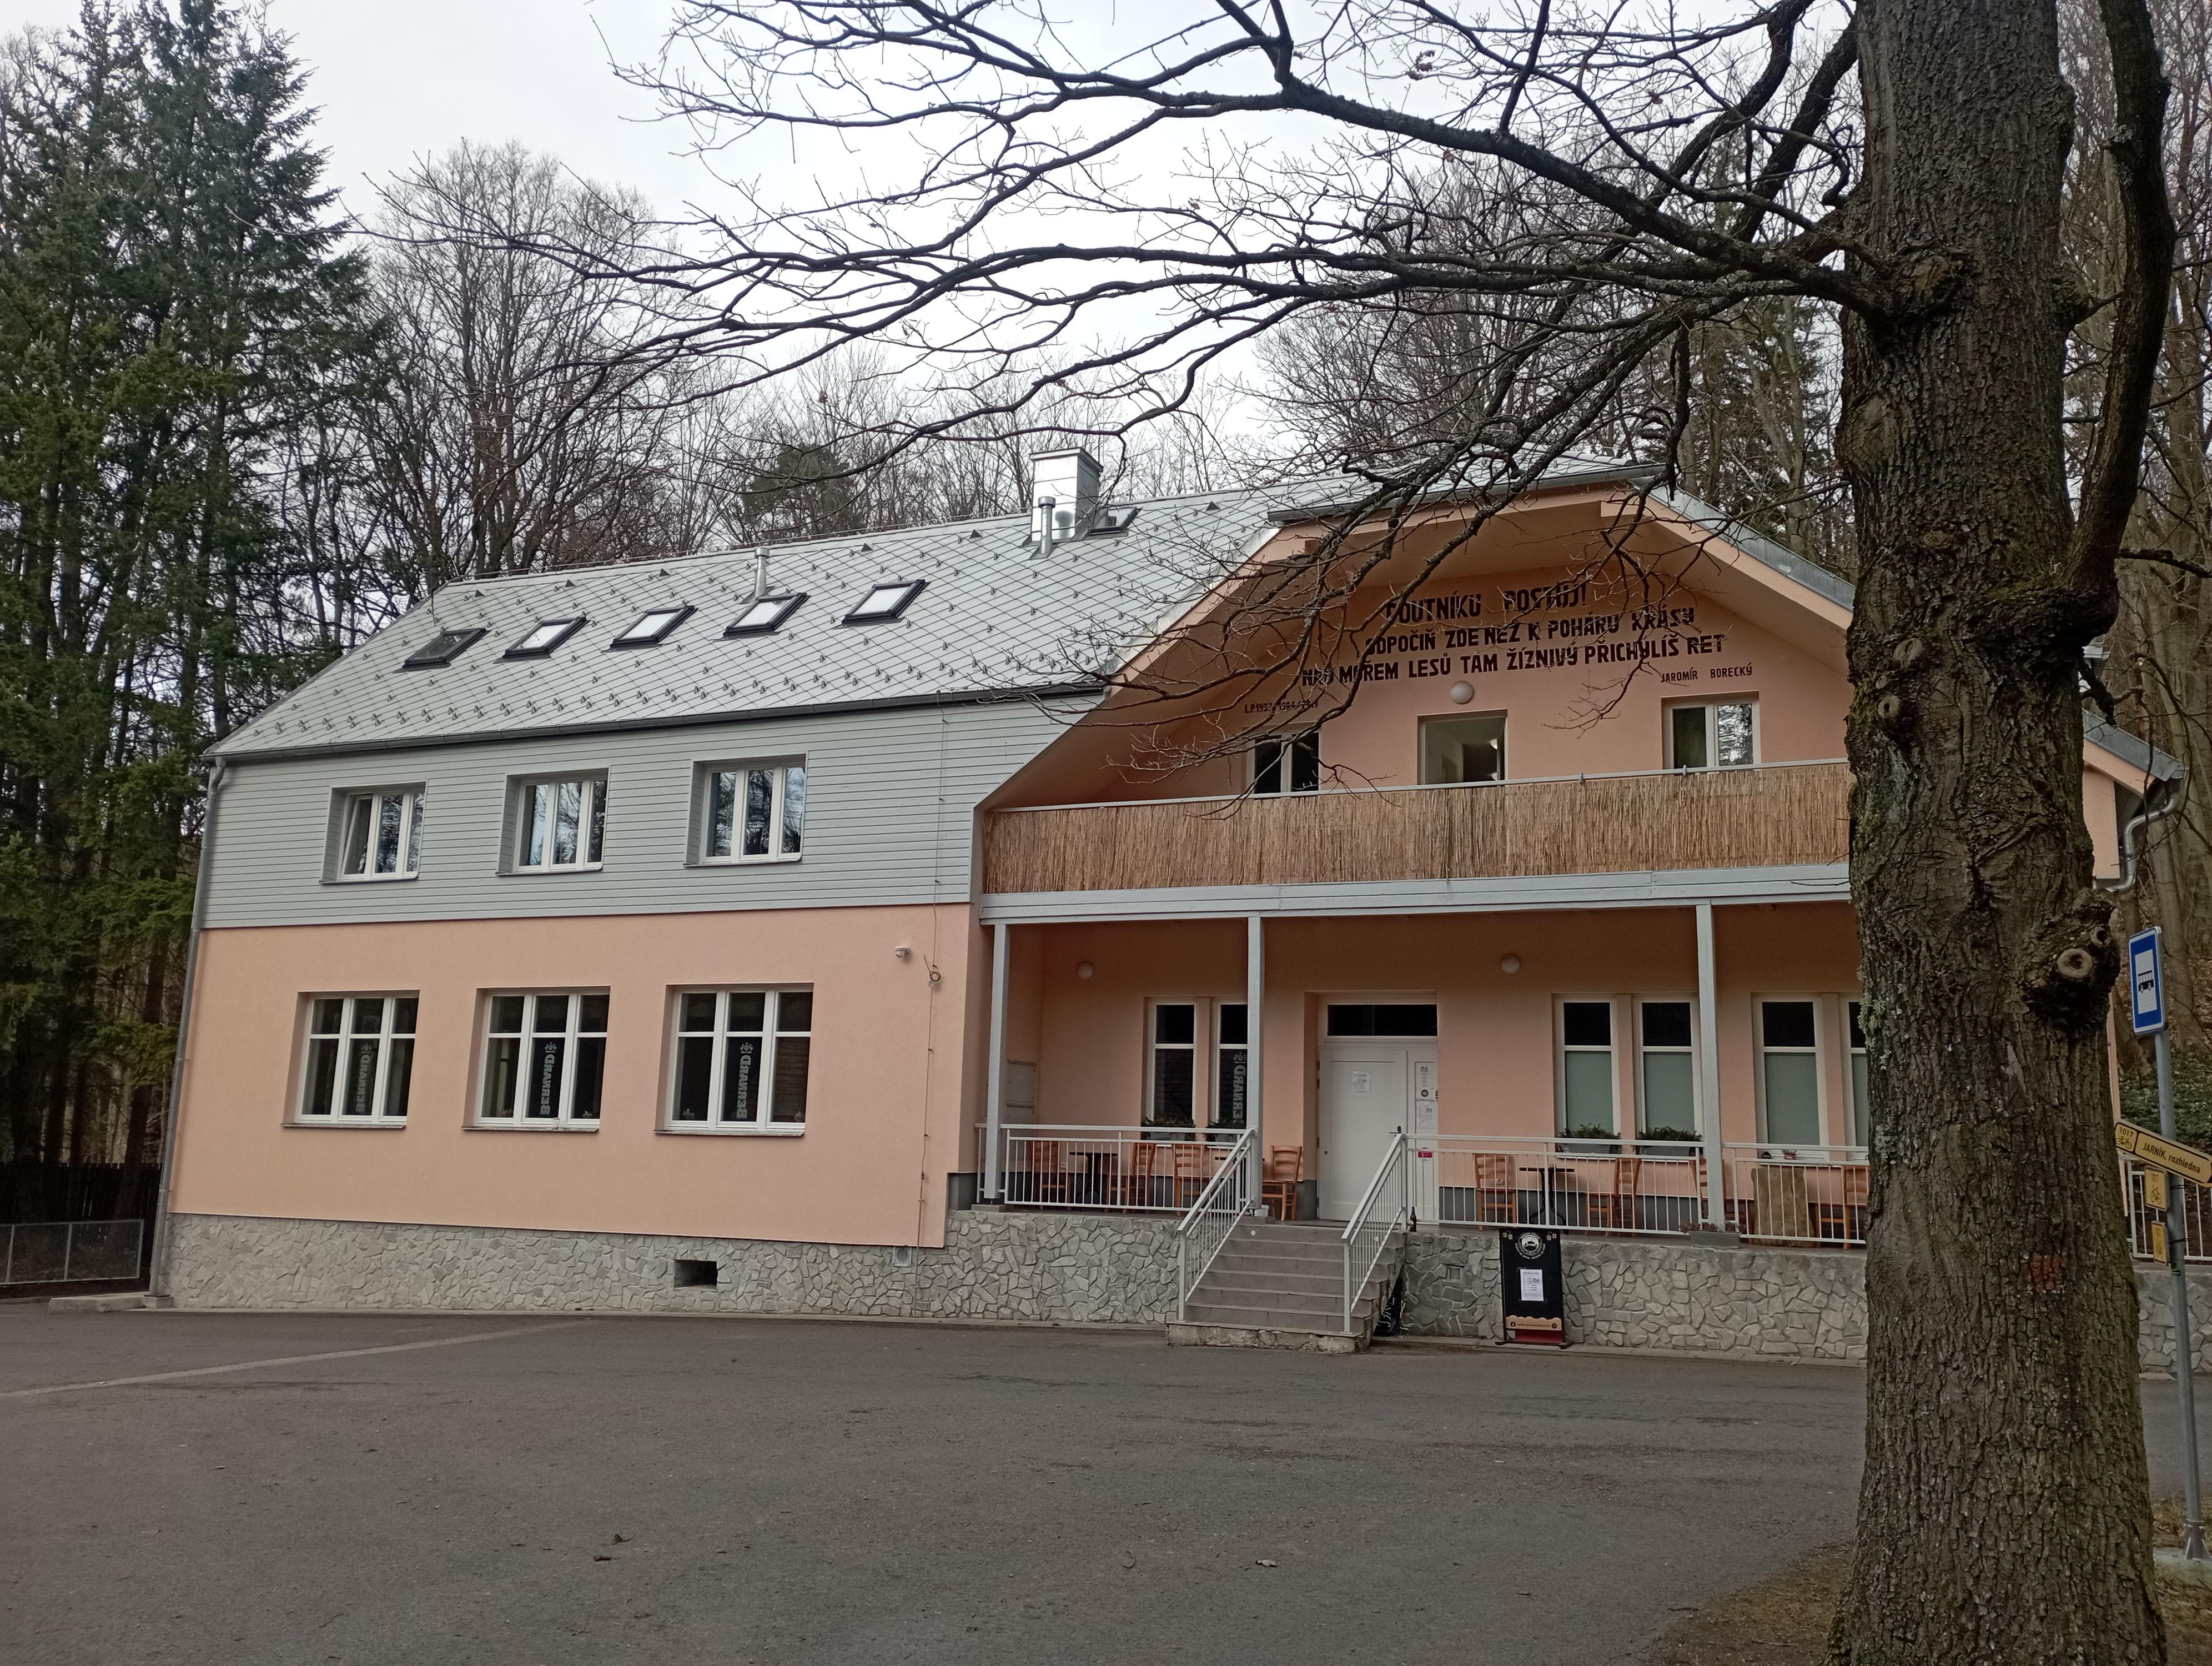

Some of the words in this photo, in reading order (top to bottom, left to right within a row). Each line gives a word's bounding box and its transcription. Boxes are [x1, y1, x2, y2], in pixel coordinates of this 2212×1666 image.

[1365, 629, 1436, 655] ODPOČIŇ
[1445, 629, 1479, 649] ZDE
[1528, 623, 1541, 641] K
[1548, 611, 1620, 639] POHÁRU
[1631, 604, 1695, 631] KRÁSY
[1302, 666, 1334, 686] NA
[1408, 652, 1451, 678] LESŮ
[1460, 653, 1498, 674] TAM
[1506, 641, 1578, 670] ŽÍZNIVÝ
[1687, 634, 1725, 655] RET
[1661, 667, 1698, 683] JAROMÍR
[1710, 662, 1753, 679] BORECKÝ
[2119, 1127, 2134, 1137] 1017
[2168, 1155, 2201, 1173] rozhledna
